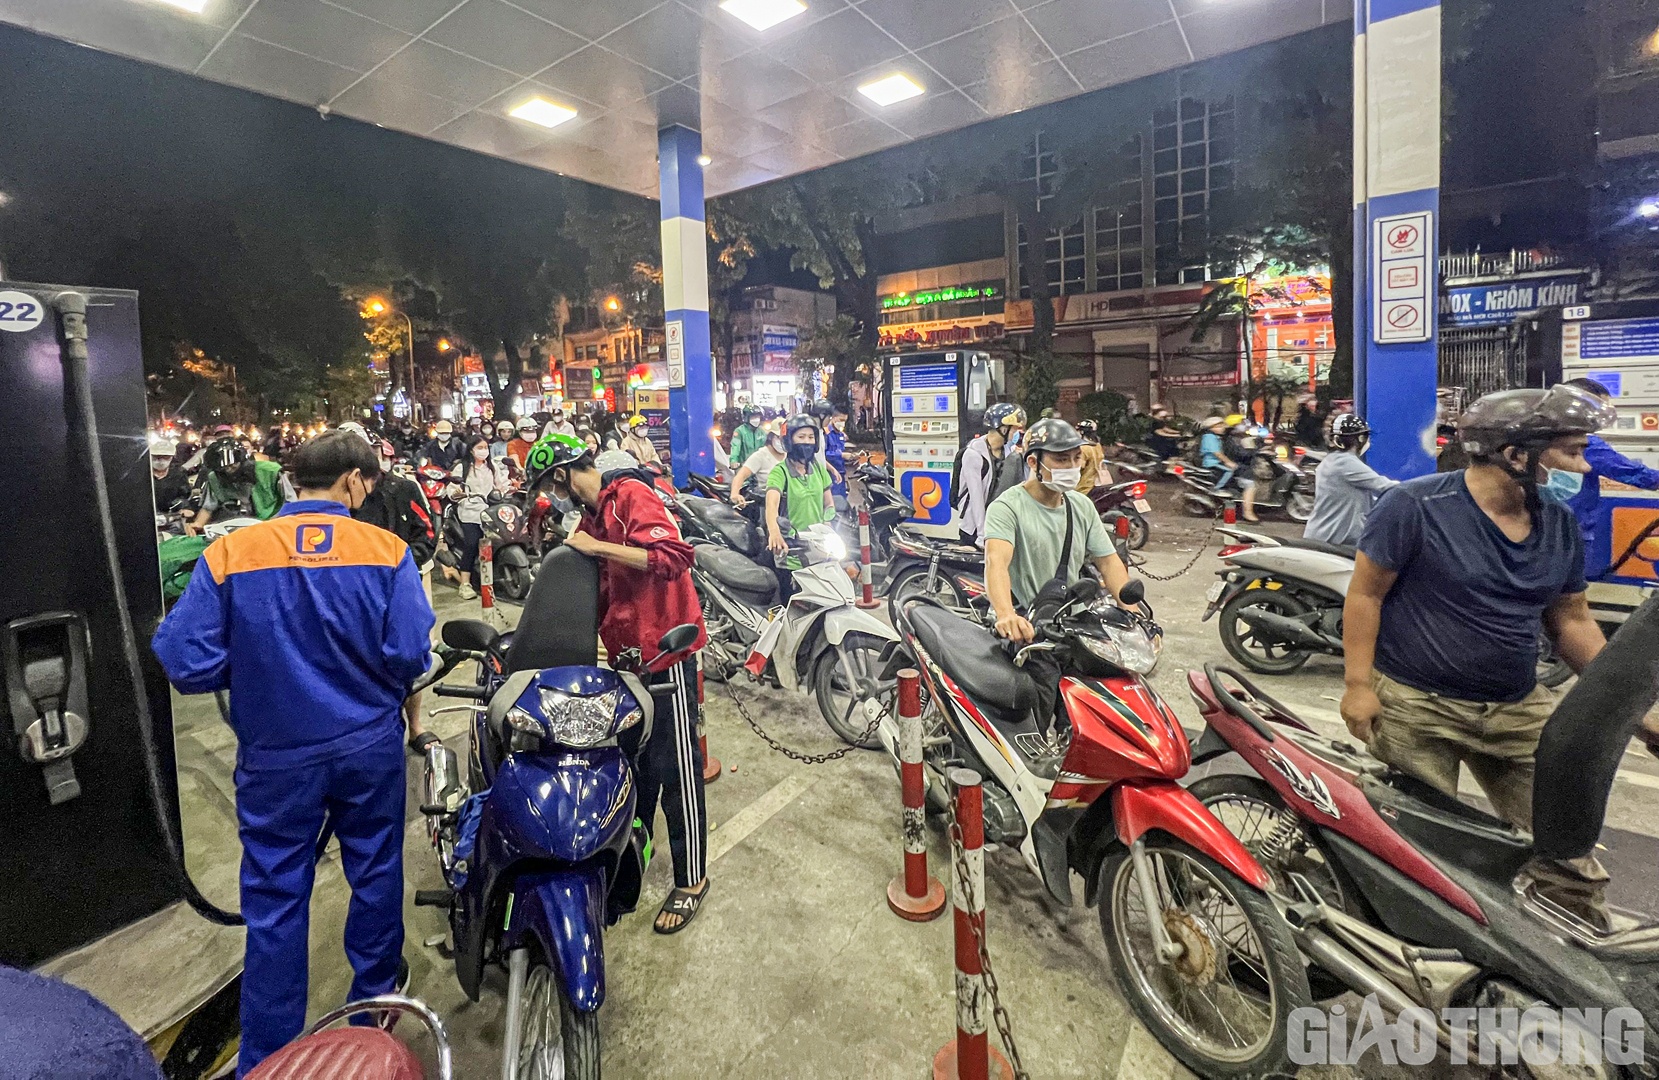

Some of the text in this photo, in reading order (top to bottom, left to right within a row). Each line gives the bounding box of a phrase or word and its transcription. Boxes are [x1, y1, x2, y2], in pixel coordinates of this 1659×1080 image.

[1485, 285, 1533, 311] NHÔM
[1537, 282, 1577, 307] KÍNH
[0, 302, 38, 321] 22
[1568, 308, 1585, 317] 18
[638, 394, 650, 402] be
[558, 758, 590, 767] HONDA
